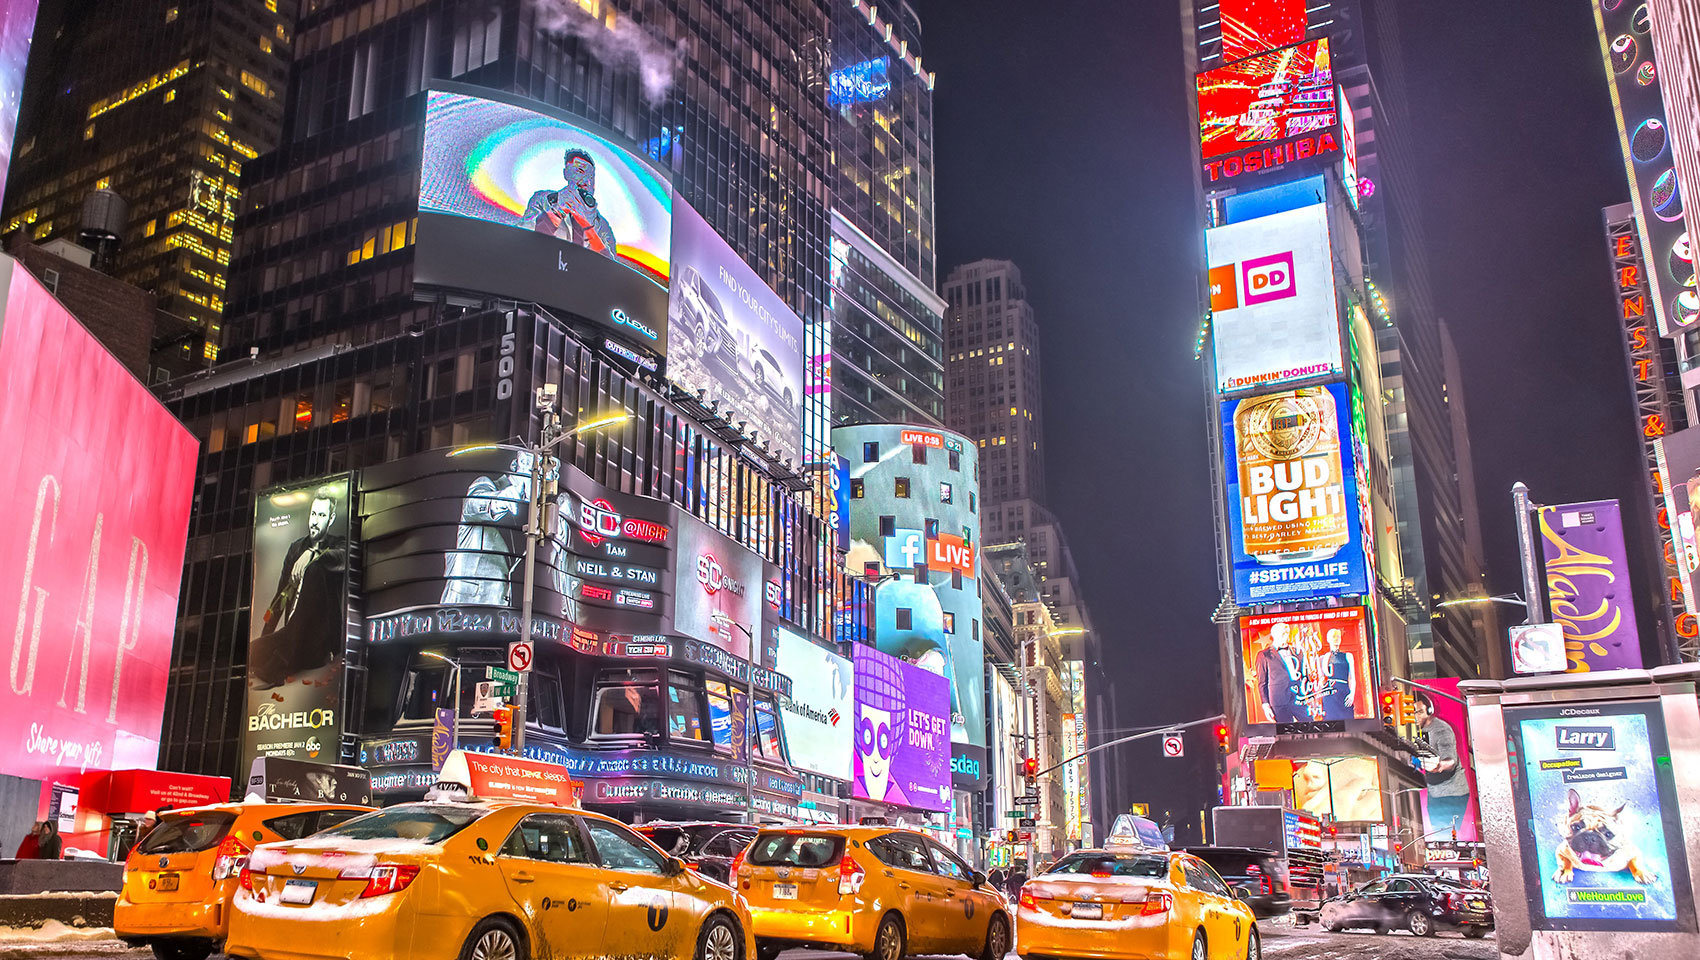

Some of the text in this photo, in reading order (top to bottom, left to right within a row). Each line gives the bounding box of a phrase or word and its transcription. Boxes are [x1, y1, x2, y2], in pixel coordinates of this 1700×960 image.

[1204, 133, 1338, 182] TOSHIBA
[1253, 270, 1285, 290] DD
[720, 265, 798, 353] FIND YOUR CITY'S LIMITS
[625, 316, 658, 340] LEXUS
[1616, 237, 1651, 381] ERNST
[1644, 414, 1665, 437] &
[497, 311, 515, 400] 1500
[1237, 363, 1328, 386] DUNKIN' DONUTS
[905, 433, 923, 442] LIVE
[1250, 459, 1330, 495] BUD
[1243, 485, 1341, 524] LIGHT
[580, 503, 621, 537] SC
[935, 543, 970, 568] LIVE
[578, 561, 656, 583] NEIL & STAN
[697, 555, 722, 591] SC
[1249, 562, 1349, 584] #SBTIX4LIFE
[10, 474, 148, 724] GAP
[581, 584, 612, 600] ESPN
[494, 669, 517, 685] Broadway
[1283, 651, 1334, 681] BANG
[248, 708, 334, 731] BACHELOR
[257, 703, 276, 716] The
[800, 703, 806, 717] of
[806, 705, 828, 725] America
[1560, 708, 1600, 716] JCDecaux
[908, 708, 946, 736] LET'S GET
[27, 722, 103, 774] Share your gift
[306, 742, 321, 751] abc
[908, 727, 935, 752] DOWN.
[1560, 729, 1608, 747] Larry
[472, 761, 488, 772] The
[489, 764, 503, 776] city
[505, 766, 521, 777] that
[1569, 890, 1644, 902] #WeHoundLove
